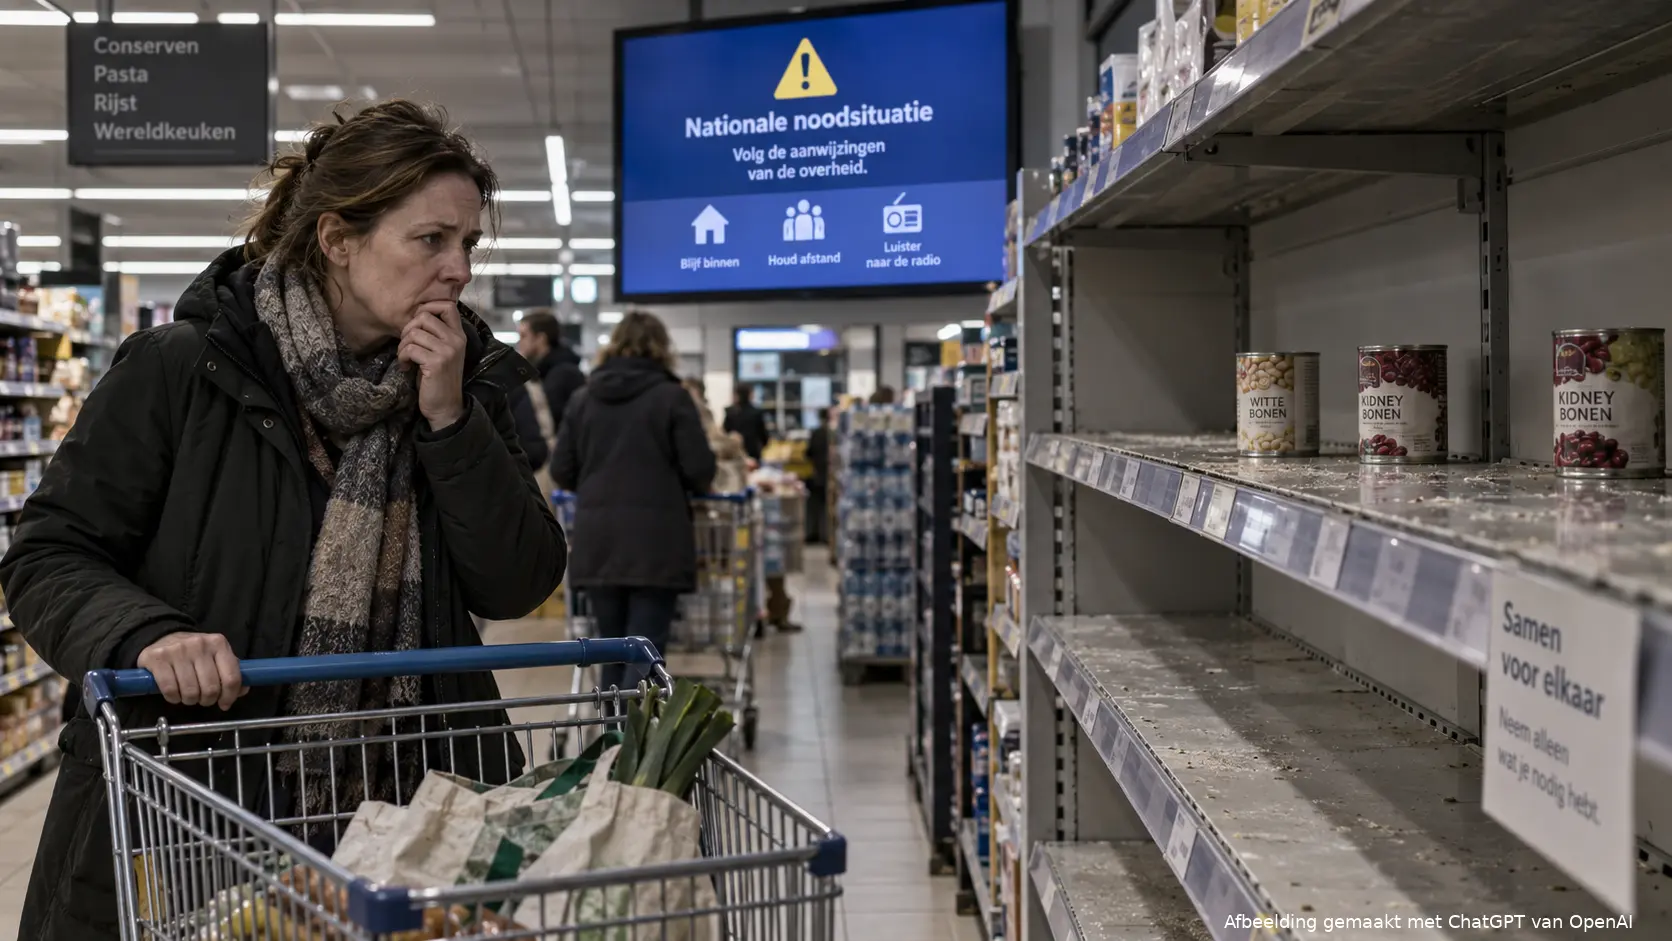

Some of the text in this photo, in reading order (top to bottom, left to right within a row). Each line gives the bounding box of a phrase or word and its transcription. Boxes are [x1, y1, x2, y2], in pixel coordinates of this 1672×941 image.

[93, 36, 200, 55] Conserven
[93, 65, 149, 83] Pasta
[93, 93, 138, 116] Rijst
[685, 100, 934, 138] Nationale noodsituatie
[93, 122, 237, 141] Wereldkeuken
[733, 140, 886, 164] Volg de aanwijzingen
[748, 160, 868, 181] van de overheid.
[884, 241, 922, 253] Luister
[703, 256, 740, 269] binnen
[768, 252, 841, 267] Houd afstand
[866, 253, 942, 269] naar de radio
[1250, 396, 1285, 408] WITTE
[1361, 395, 1404, 407] KIDNEY
[1558, 391, 1615, 405] KIDNEY
[1249, 408, 1287, 419] BONEN
[1362, 408, 1401, 420] BONEN
[1560, 407, 1612, 421] BONEN
[1503, 601, 1562, 653] Samen
[1502, 652, 1605, 720] voor elkaar
[1499, 705, 1570, 766] Neem alleen
[1497, 746, 1602, 826] wat je nodig hebt.
